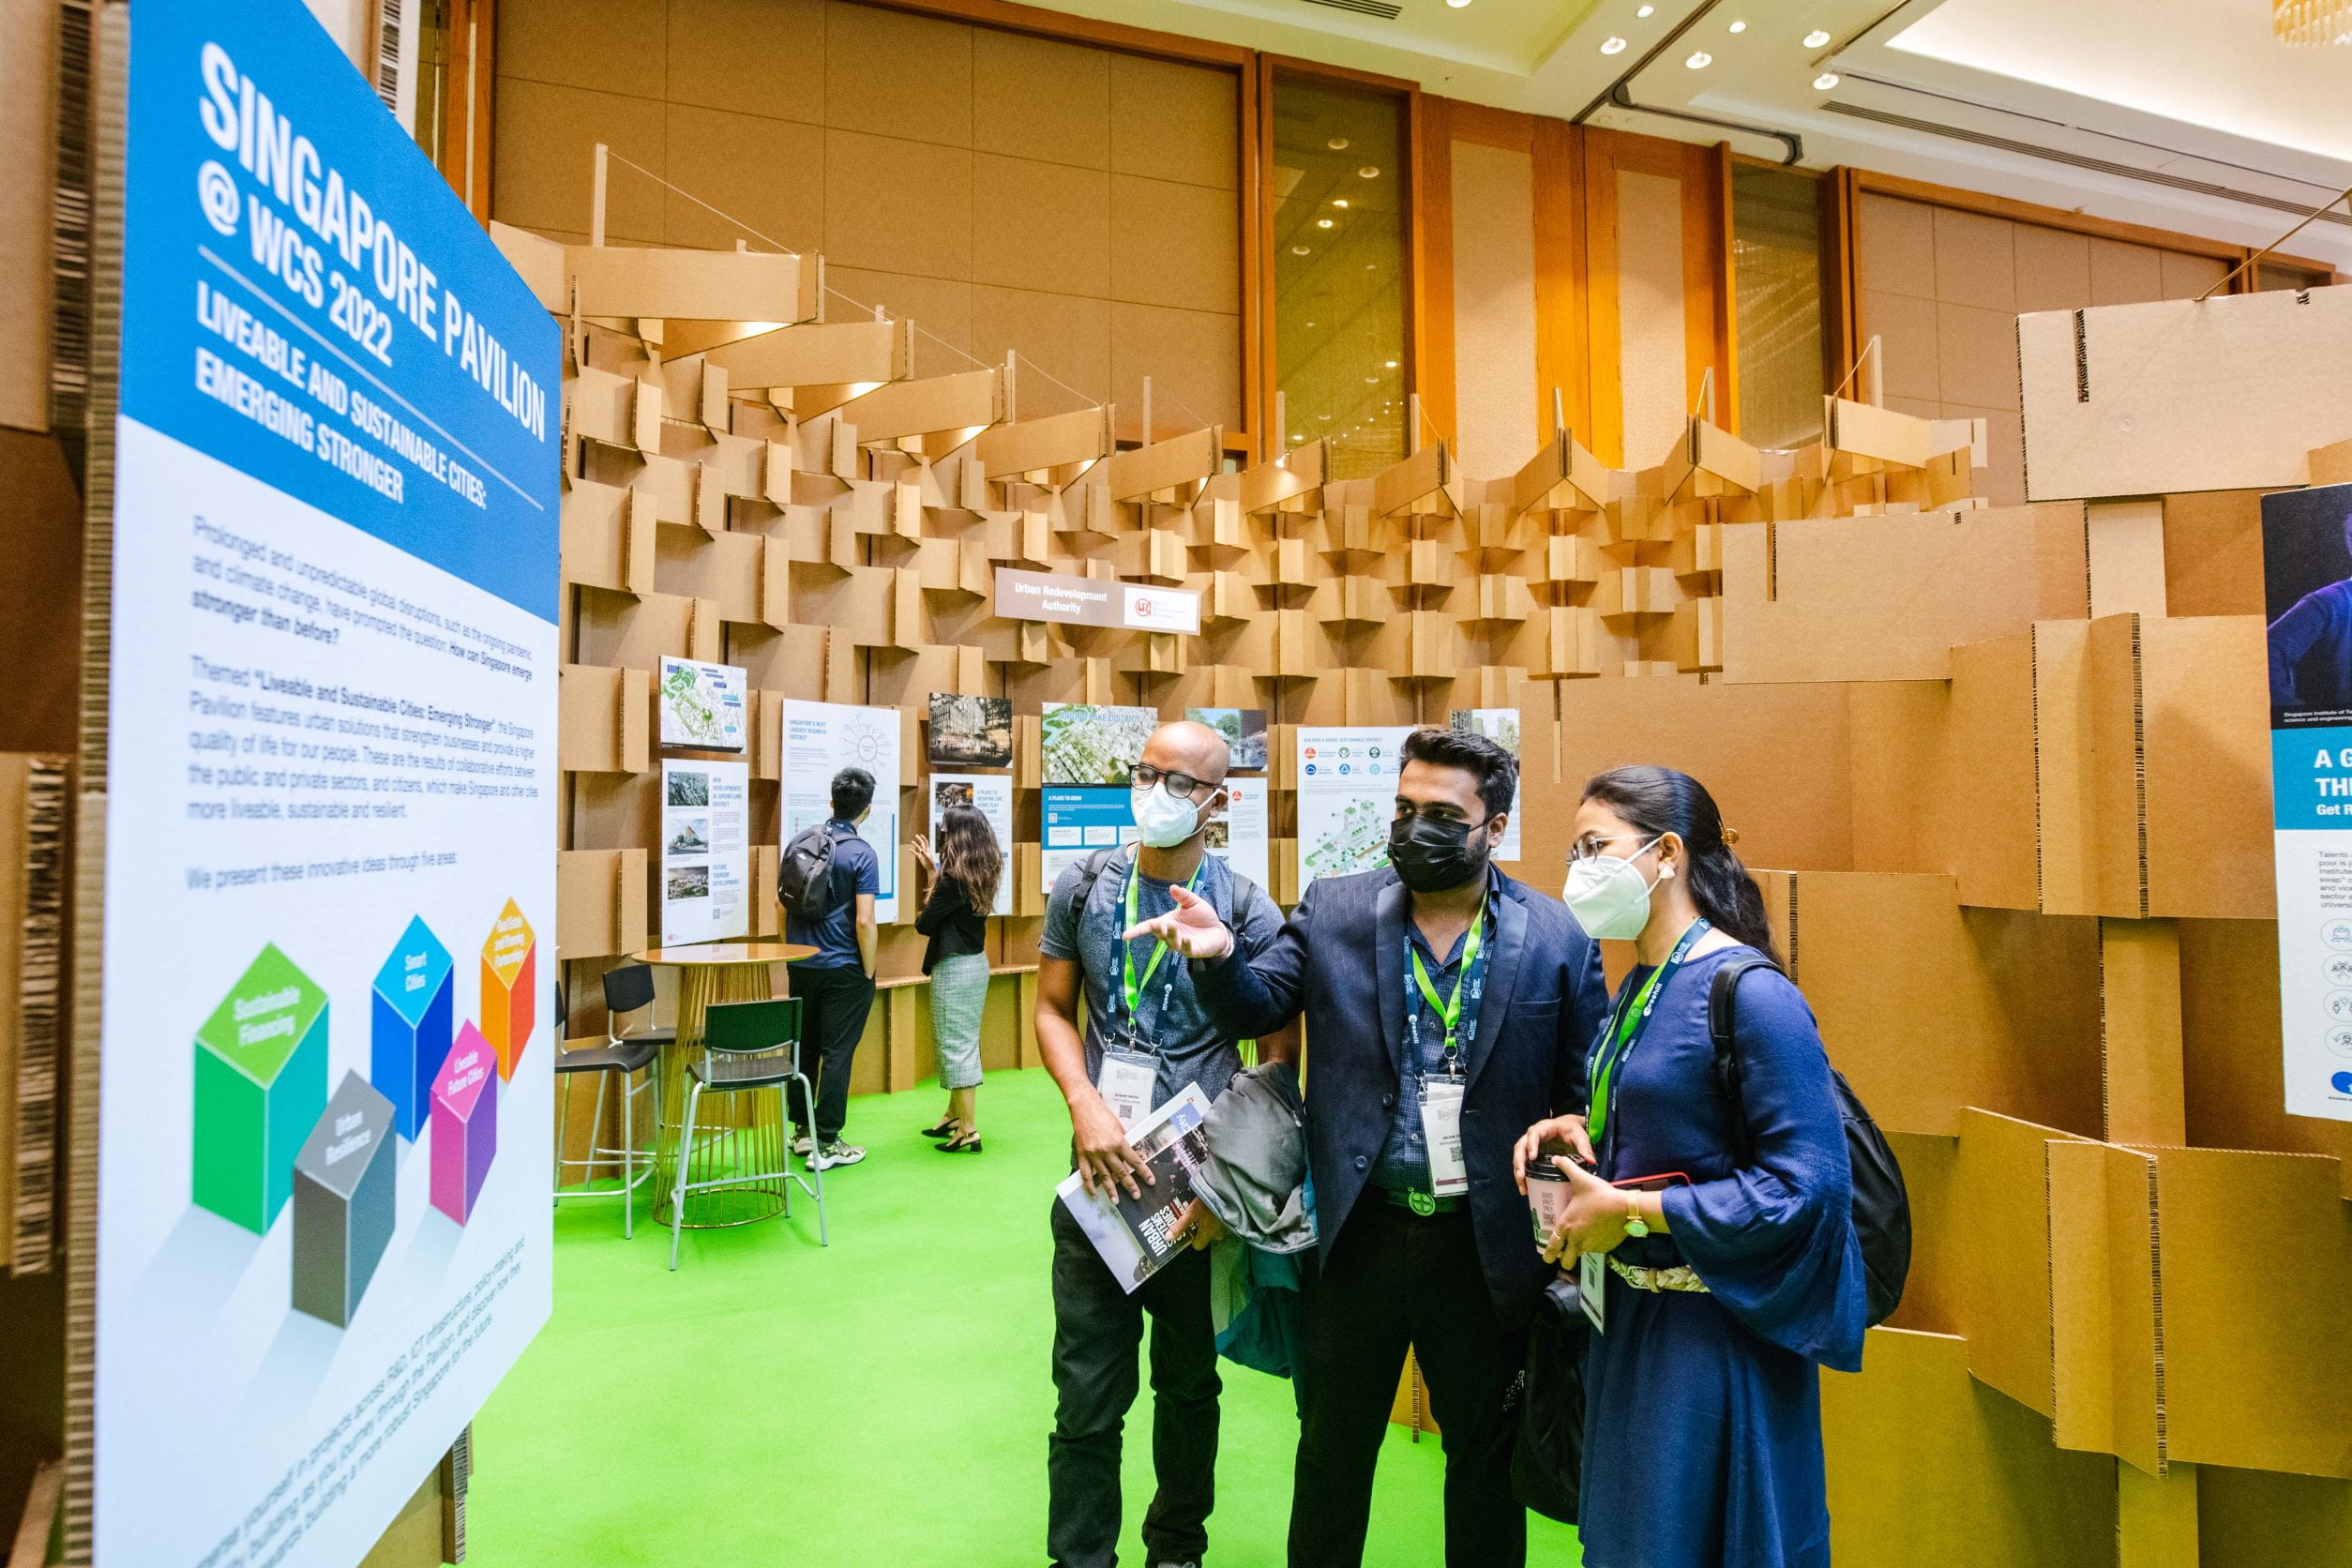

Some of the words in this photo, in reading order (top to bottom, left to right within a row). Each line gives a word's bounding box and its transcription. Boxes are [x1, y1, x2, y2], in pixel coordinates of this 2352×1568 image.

[198, 159, 240, 236] @
[248, 193, 324, 309] WCS
[329, 270, 393, 369] 2022
[200, 41, 437, 342] SINGAPORE
[445, 289, 545, 444] PAVILION
[197, 279, 307, 389] LIVEABLE
[308, 361, 348, 415] AND
[351, 390, 446, 485] SUSTAINABLE
[448, 460, 487, 510] CITIES:
[195, 346, 315, 454] EMERGING
[316, 422, 404, 505] STRONGER
[194, 514, 267, 563] Prolonged
[270, 549, 294, 572] and
[296, 561, 368, 600] unpredictable
[369, 585, 397, 611] global
[445, 615, 461, 634] such
[462, 625, 471, 639] as
[471, 626, 482, 642] the
[483, 633, 506, 655] ongoing
[506, 641, 533, 662] pandemic
[1015, 582, 1041, 595] Urban
[1043, 585, 1108, 603] Redevelopment
[1042, 600, 1081, 615] Authority
[192, 589, 258, 625] stronger
[260, 606, 292, 632] than
[294, 616, 339, 646] before?
[193, 554, 222, 580] and
[225, 565, 275, 596] climate
[325, 596, 352, 622] have
[353, 610, 397, 638] prompted
[399, 624, 413, 642] the
[449, 641, 465, 658] How
[466, 650, 479, 662] can
[480, 650, 511, 673] Singapore
[512, 664, 533, 683] emerge
[190, 655, 251, 687] Themed
[316, 684, 339, 703] and
[340, 686, 398, 715] Sustainable
[427, 704, 463, 730] Emerging
[498, 720, 508, 734] the
[508, 722, 535, 740] Singapore
[190, 690, 248, 718] Pavilion
[249, 700, 301, 727] features
[304, 710, 335, 732] urban
[338, 716, 381, 739] solutions
[383, 722, 400, 741] that
[401, 726, 442, 748] strengthen
[444, 732, 480, 752] businesses
[481, 739, 492, 753] and
[493, 741, 515, 758] provide
[520, 745, 535, 761] higher
[188, 730, 237, 758] quality
[242, 732, 256, 754] of
[259, 733, 278, 757] life
[280, 736, 299, 758] for
[301, 743, 320, 760] our
[362, 745, 389, 766] These
[392, 751, 405, 768] are
[407, 751, 420, 769] the
[421, 754, 445, 771] results
[447, 758, 456, 772] of
[456, 759, 495, 776] collaborative
[496, 761, 514, 777] efforts
[514, 764, 536, 779] between
[2314, 748, 2333, 768] A
[188, 761, 213, 786] the
[217, 764, 259, 792] public
[264, 767, 288, 789] and
[290, 770, 328, 793] private
[372, 776, 389, 792] and
[427, 777, 447, 795] which
[448, 780, 467, 795] make
[468, 780, 499, 799] Singapore
[499, 784, 510, 797] and
[511, 784, 525, 797] other
[188, 801, 227, 820] more
[287, 799, 349, 820] sustainable
[352, 800, 369, 819] and
[2316, 804, 2341, 816] Get
[186, 867, 211, 890] We
[215, 867, 267, 892] present
[271, 861, 305, 883] these
[308, 857, 359, 880] innovative
[362, 854, 386, 873] ideas
[388, 852, 419, 873] through
[421, 850, 435, 867] five
[1138, 1218, 1168, 1257] URBAN
[1151, 1213, 1176, 1247] STEMS
